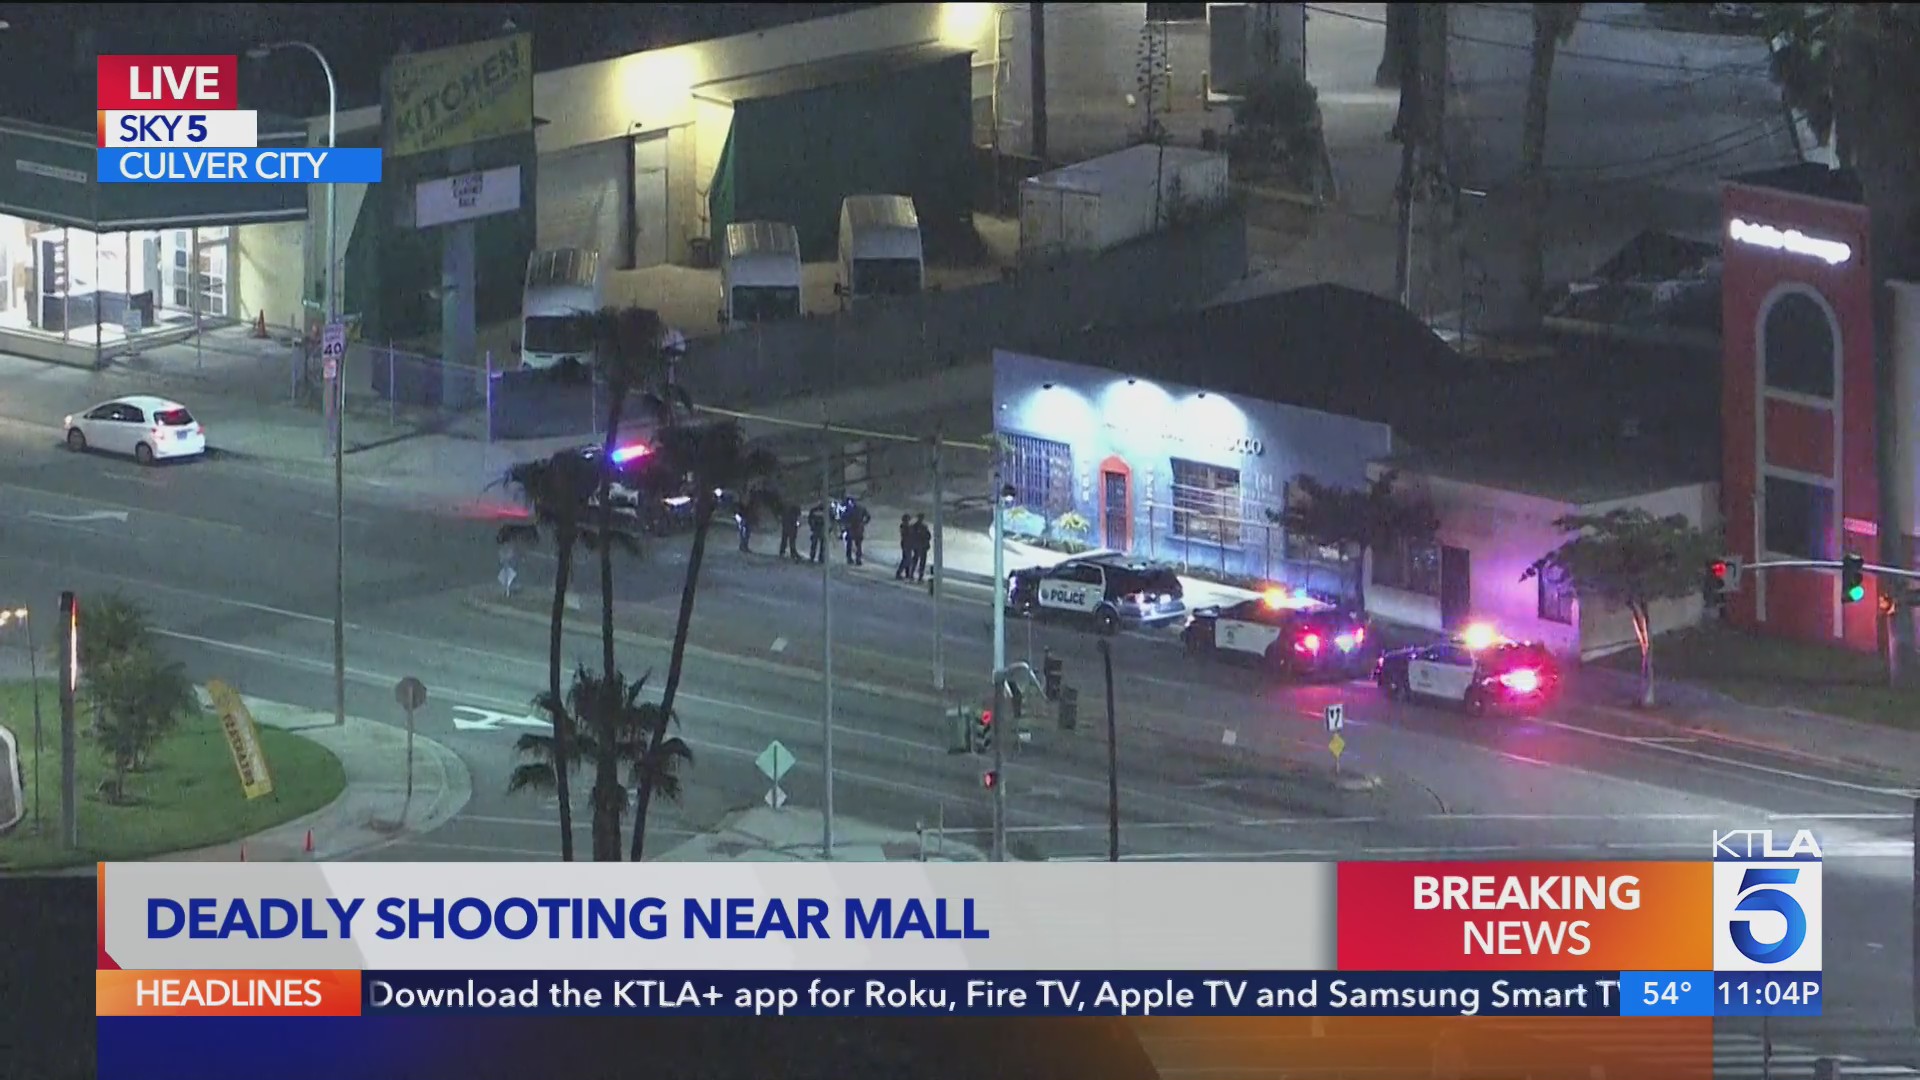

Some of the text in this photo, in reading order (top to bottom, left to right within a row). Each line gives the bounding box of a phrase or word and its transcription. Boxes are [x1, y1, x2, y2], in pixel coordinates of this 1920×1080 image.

[396, 40, 520, 141] KITCHEN
[324, 342, 342, 355] 40
[1050, 589, 1086, 605] POLICE
